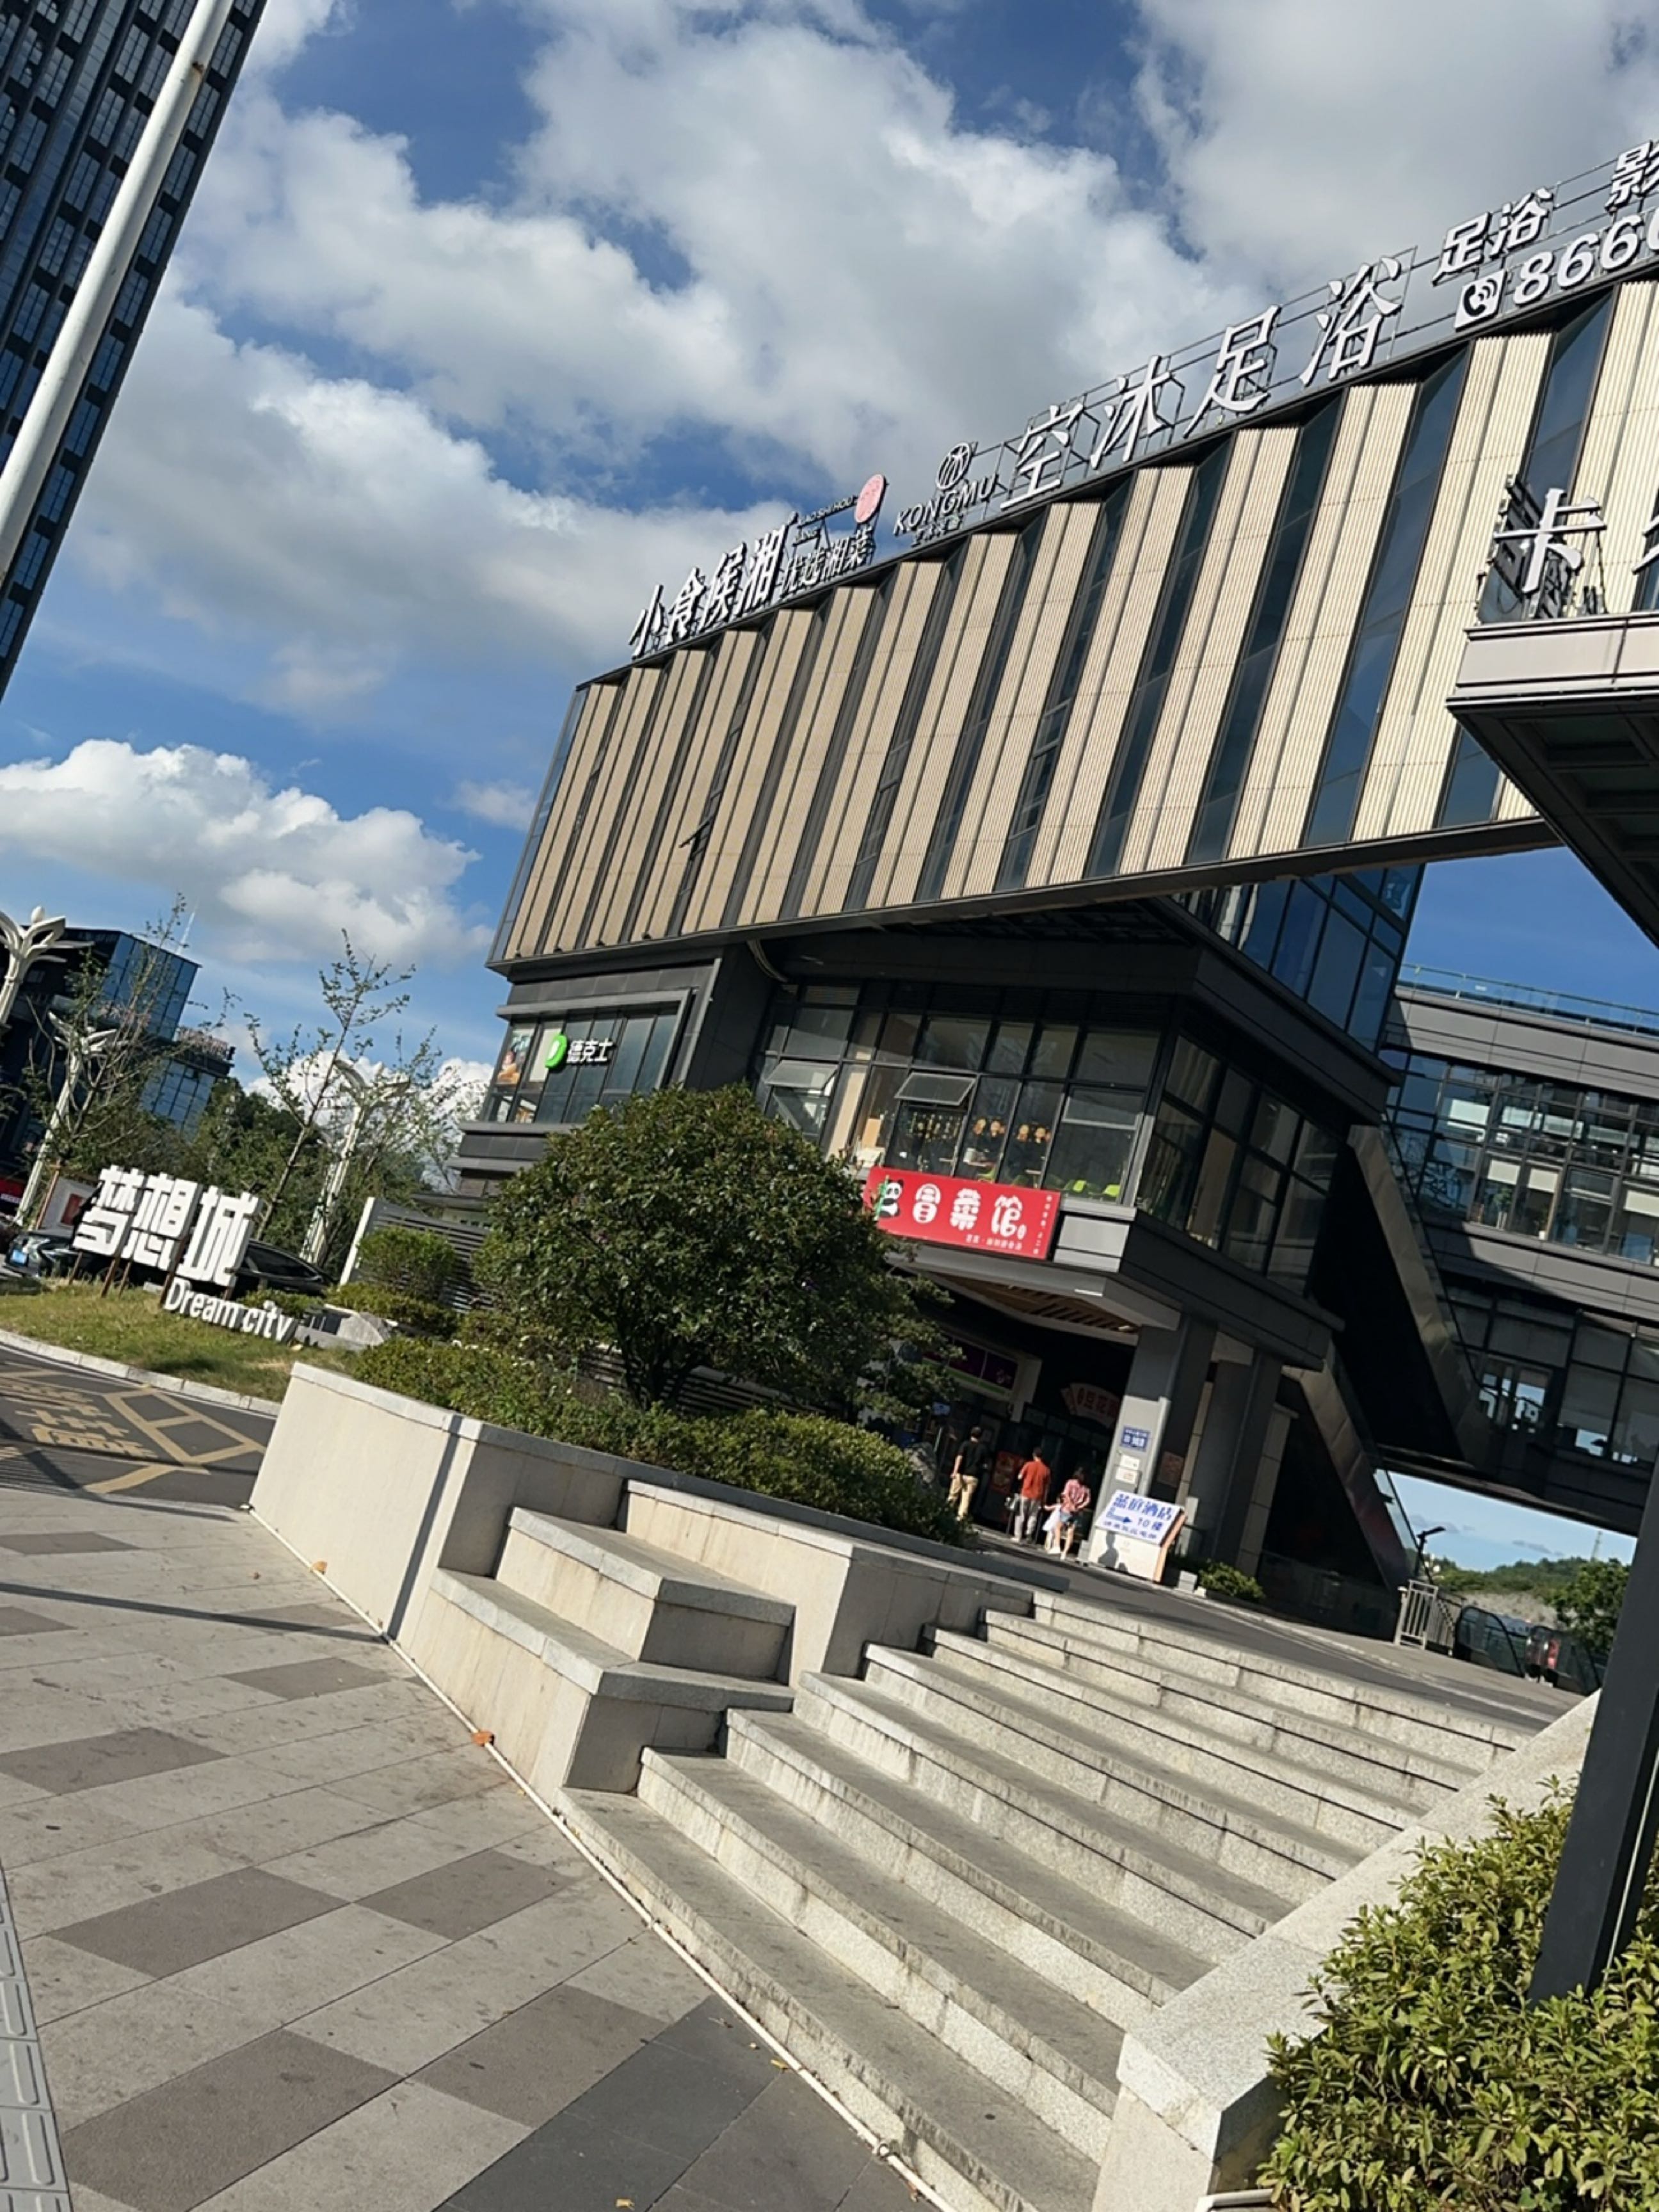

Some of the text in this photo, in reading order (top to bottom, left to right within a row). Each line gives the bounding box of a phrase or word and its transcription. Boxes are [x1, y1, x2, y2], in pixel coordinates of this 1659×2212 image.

[1432, 188, 1554, 285] 足浴
[1000, 257, 1402, 511] 空沐足浴
[894, 474, 999, 536] KONGMU
[1492, 488, 1659, 595] 卡
[566, 1038, 614, 1063] 德克士
[72, 1164, 260, 1286] 梦想城
[913, 1183, 1023, 1237] 冒菜馆
[163, 1276, 296, 1342] Dream city
